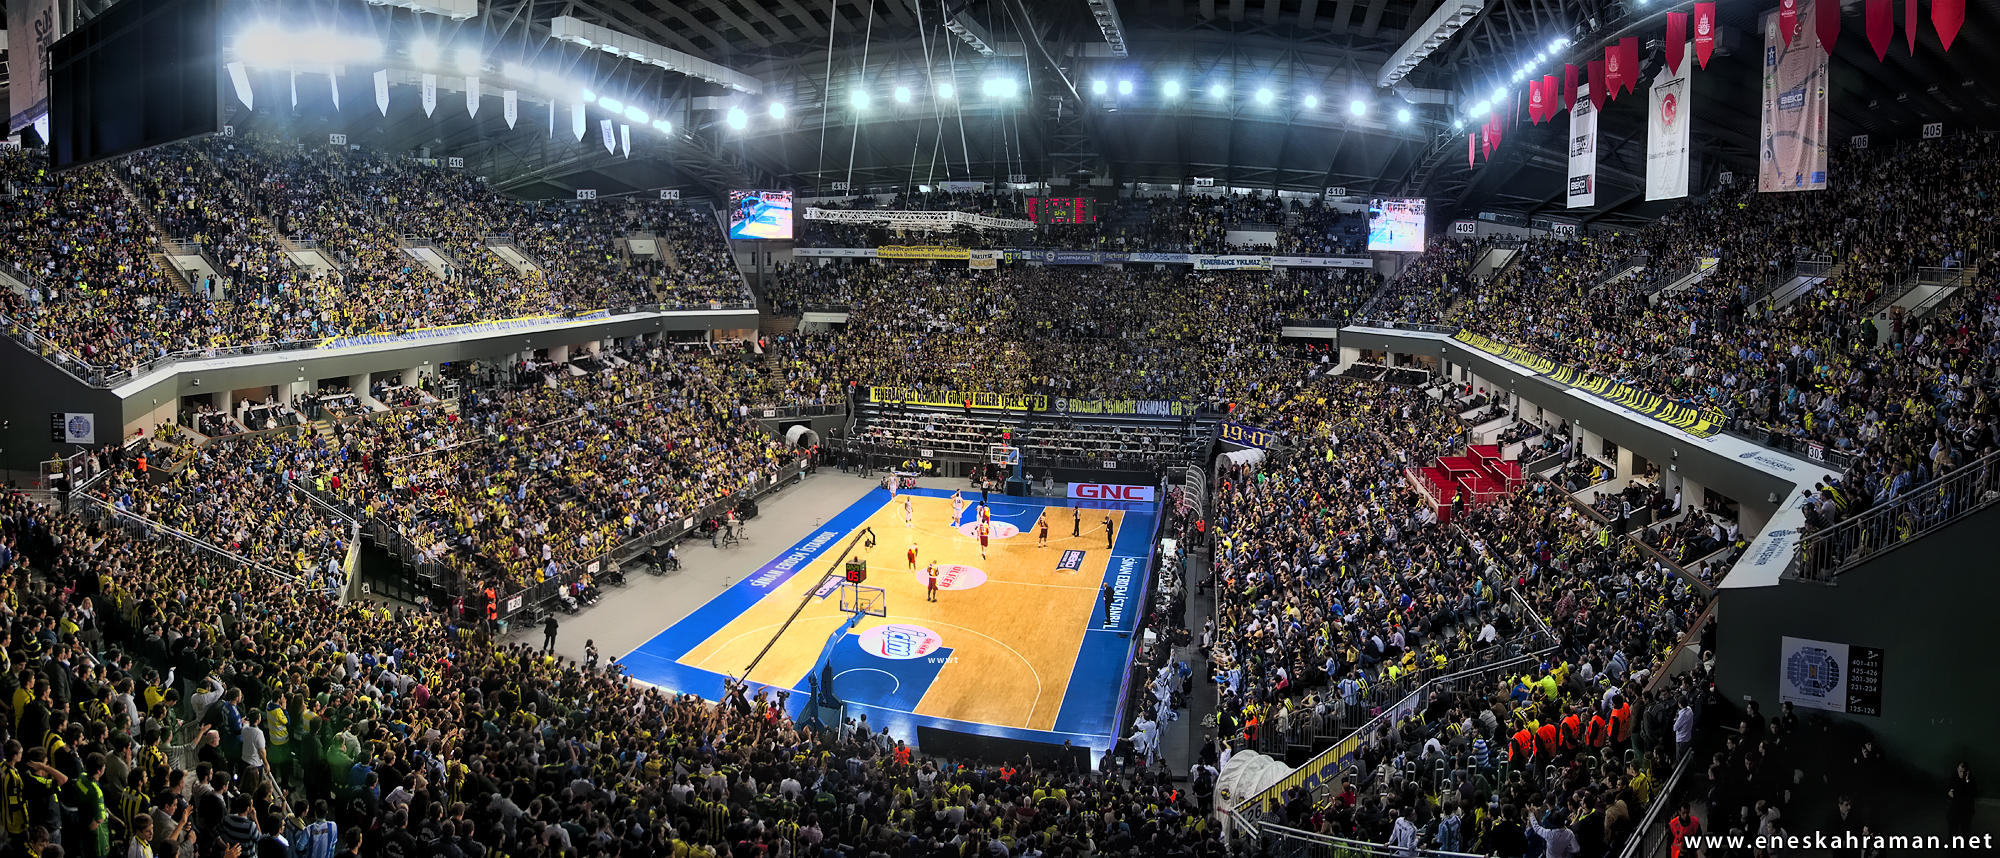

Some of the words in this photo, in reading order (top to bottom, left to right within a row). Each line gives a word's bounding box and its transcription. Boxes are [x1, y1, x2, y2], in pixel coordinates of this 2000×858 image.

[1781, 93, 1803, 105] BEKO
[1923, 124, 1942, 137] 405
[330, 135, 346, 144] 417
[1852, 136, 1868, 148] 406
[449, 158, 463, 167] 416
[1570, 180, 1586, 190] BEKO
[577, 191, 596, 199] 415
[661, 191, 679, 199] 414
[1327, 188, 1344, 196] 410
[1456, 223, 1475, 233] 409
[1555, 225, 1575, 236] 408
[1024, 395, 1046, 409] GFB
[1170, 401, 1183, 415] GFB
[1653, 401, 1698, 428] OLUR
[1809, 447, 1824, 461] 303
[1075, 483, 1145, 500] GNC
[1064, 551, 1081, 568] BEKO
[749, 569, 785, 588] SİNAN
[775, 551, 806, 571] ERDEM
[1118, 557, 1138, 575] SİNAN
[847, 571, 859, 582] 05
[1114, 575, 1131, 596] ERDEM
[509, 596, 522, 610] 120
[1852, 659, 1878, 668] 401-411
[1851, 668, 1878, 676] 425-426
[1851, 675, 1878, 684] 301-309
[1850, 683, 1877, 692] 231-234
[1849, 705, 1875, 714] 125-126
